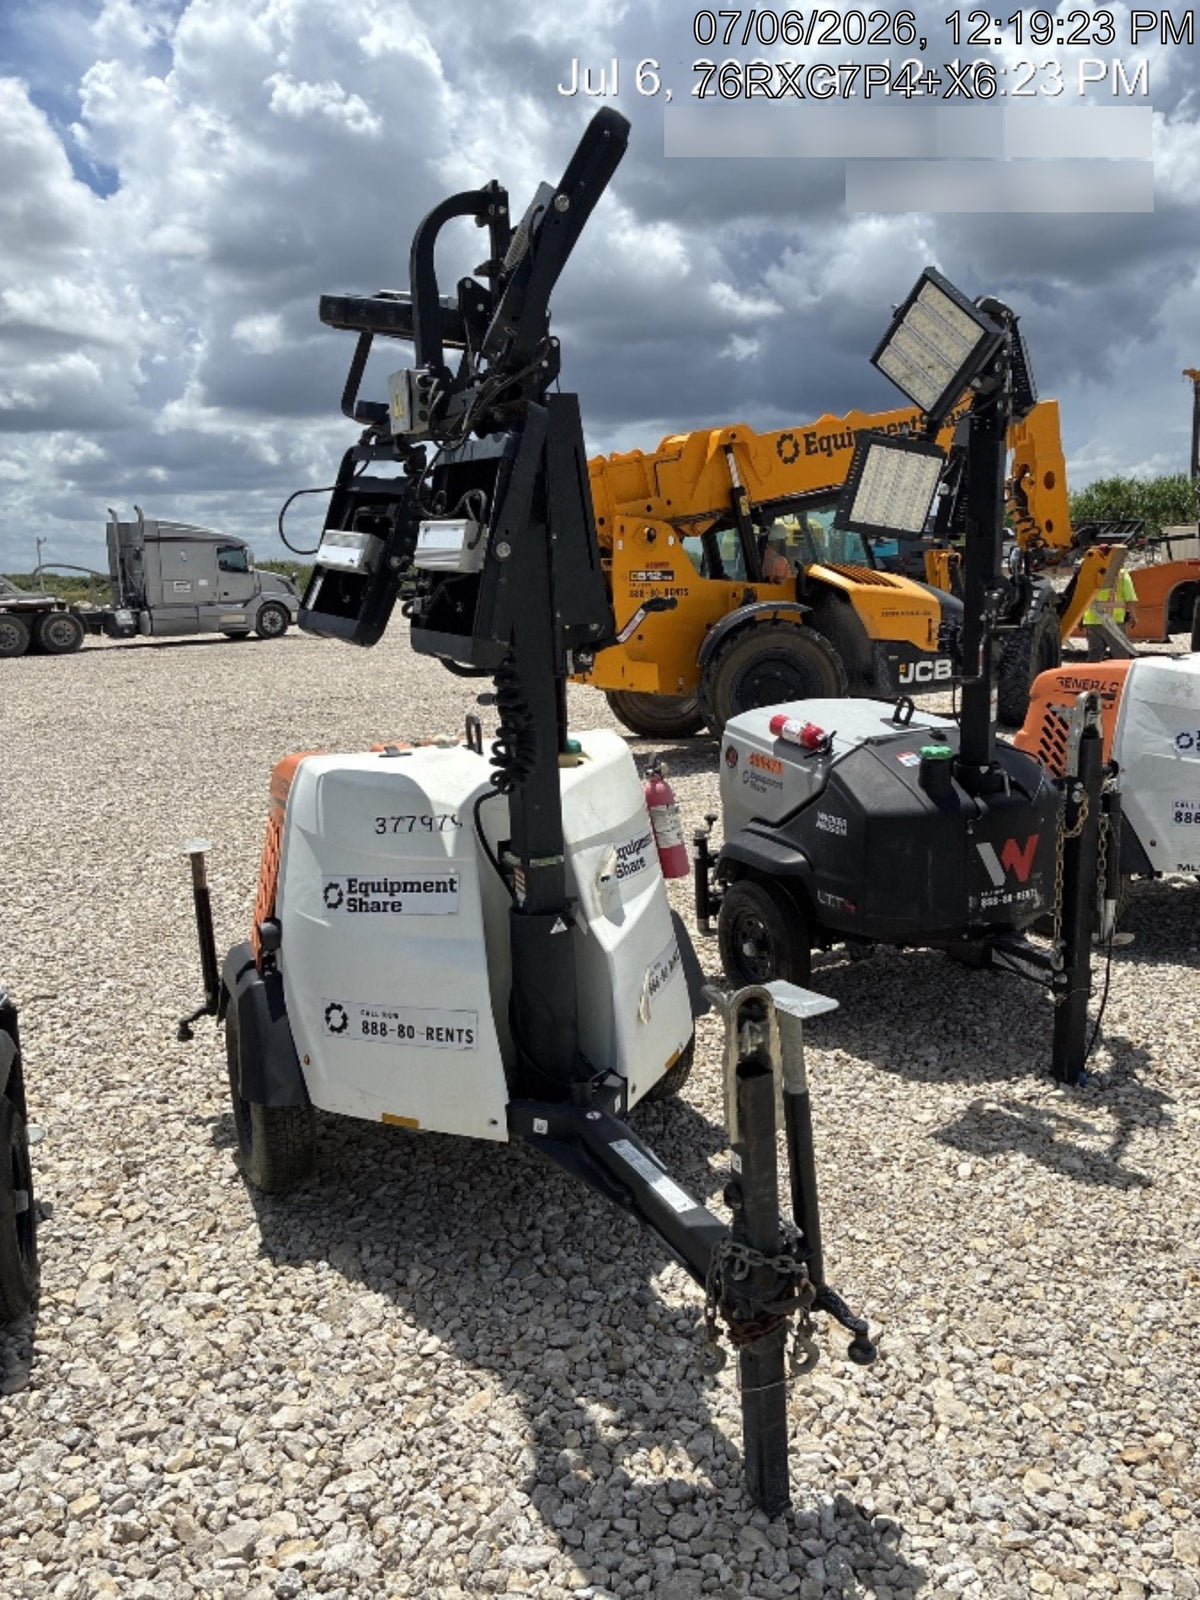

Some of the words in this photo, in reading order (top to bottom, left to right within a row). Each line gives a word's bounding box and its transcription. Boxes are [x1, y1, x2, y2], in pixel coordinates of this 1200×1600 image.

[900, 659, 952, 683] JCB
[346, 878, 458, 897] Equipment
[346, 898, 402, 913] Share
[361, 1009, 379, 1018] CALL
[362, 1020, 474, 1044] 888-80-RENTS
